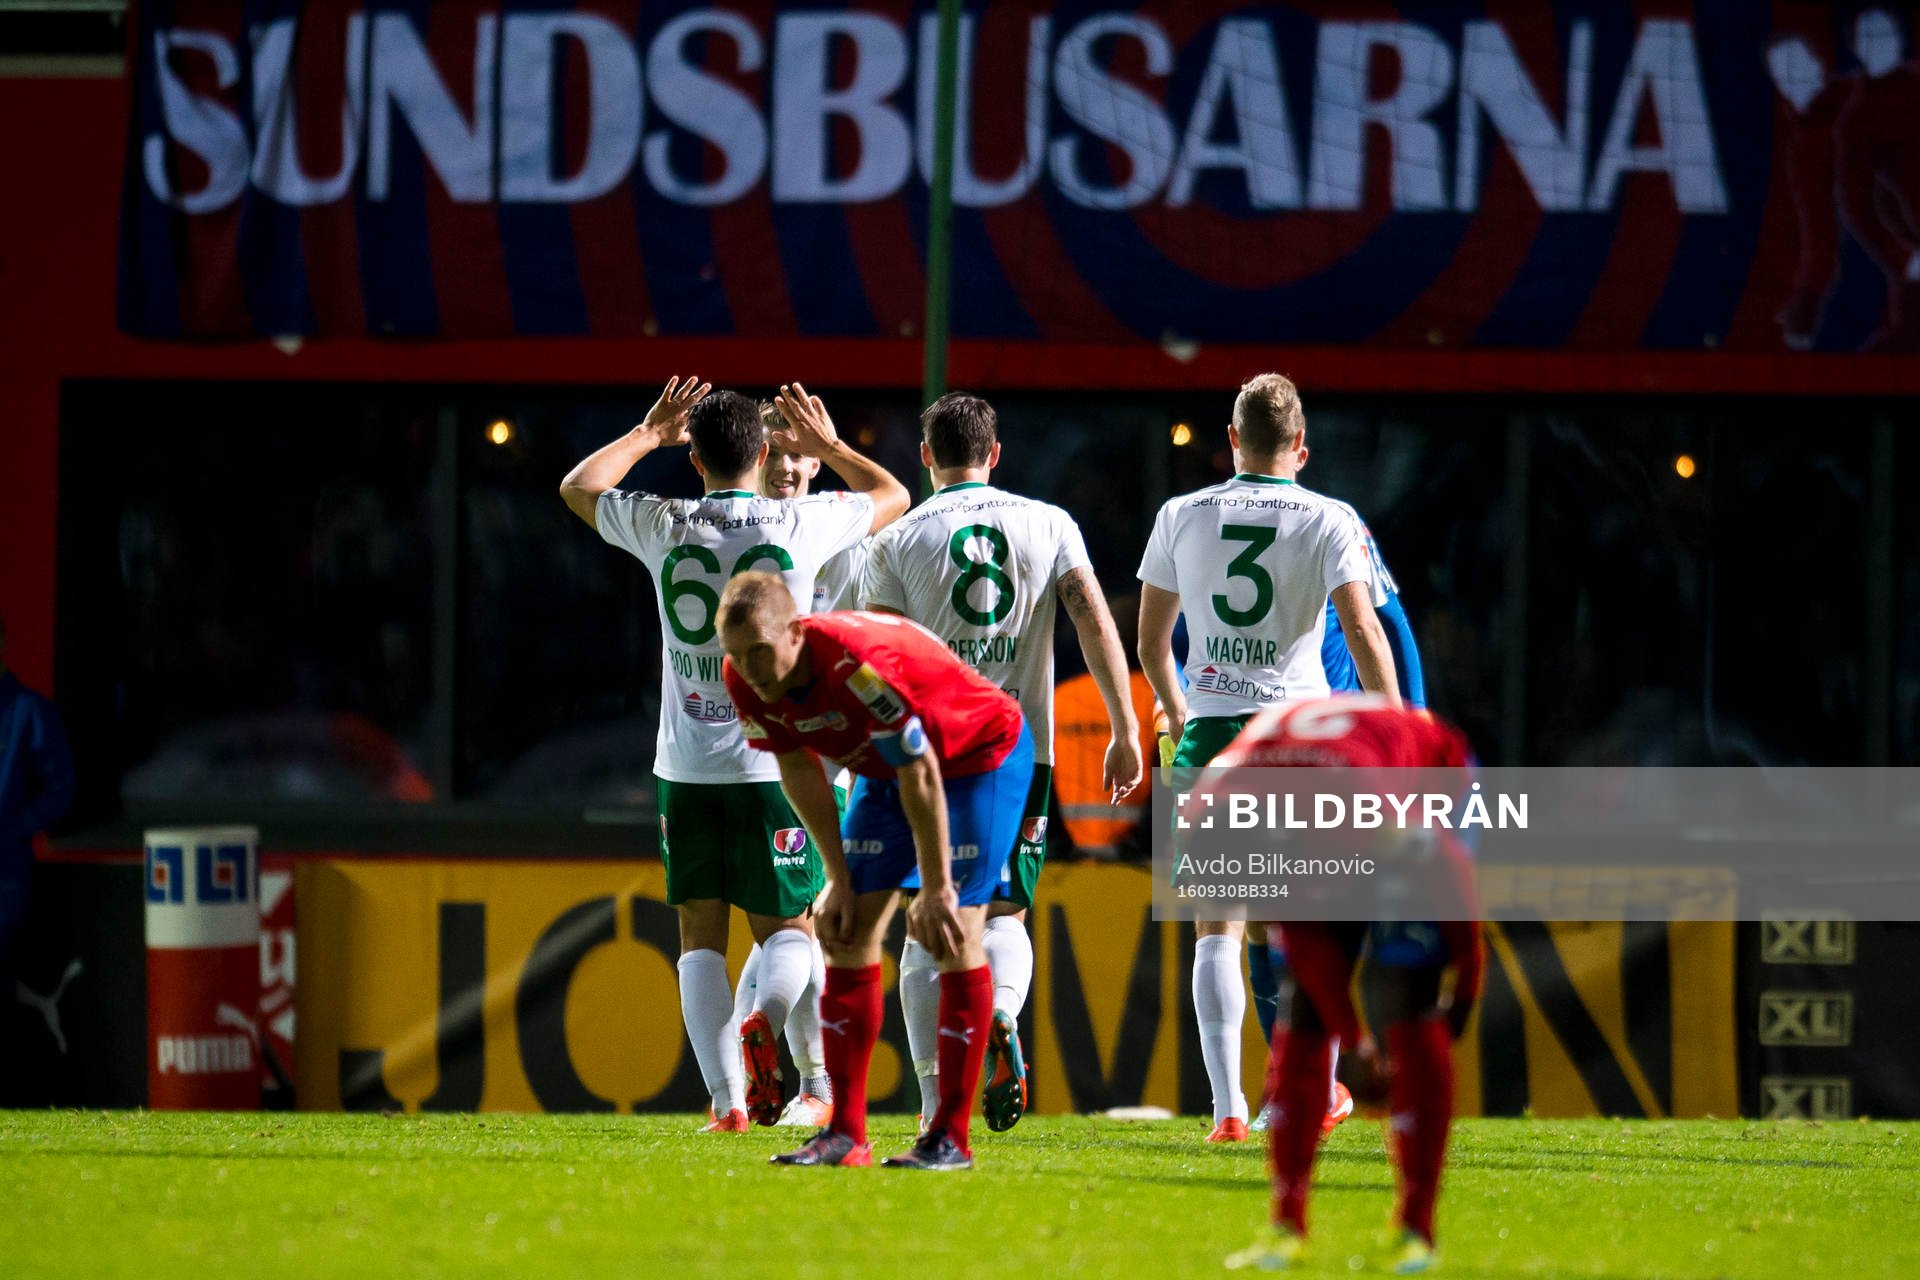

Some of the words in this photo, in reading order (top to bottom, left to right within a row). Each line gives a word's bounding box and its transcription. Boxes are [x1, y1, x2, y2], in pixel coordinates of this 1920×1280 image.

[143, 10, 1729, 214] SUNDSBUSARNA
[1244, 498, 1313, 513] pantbank
[950, 524, 1015, 626] 8
[1212, 524, 1277, 627] 3
[1206, 637, 1277, 666] MAGYAR
[1769, 998, 1842, 1038] XL
[157, 1033, 253, 1075] PUMA
